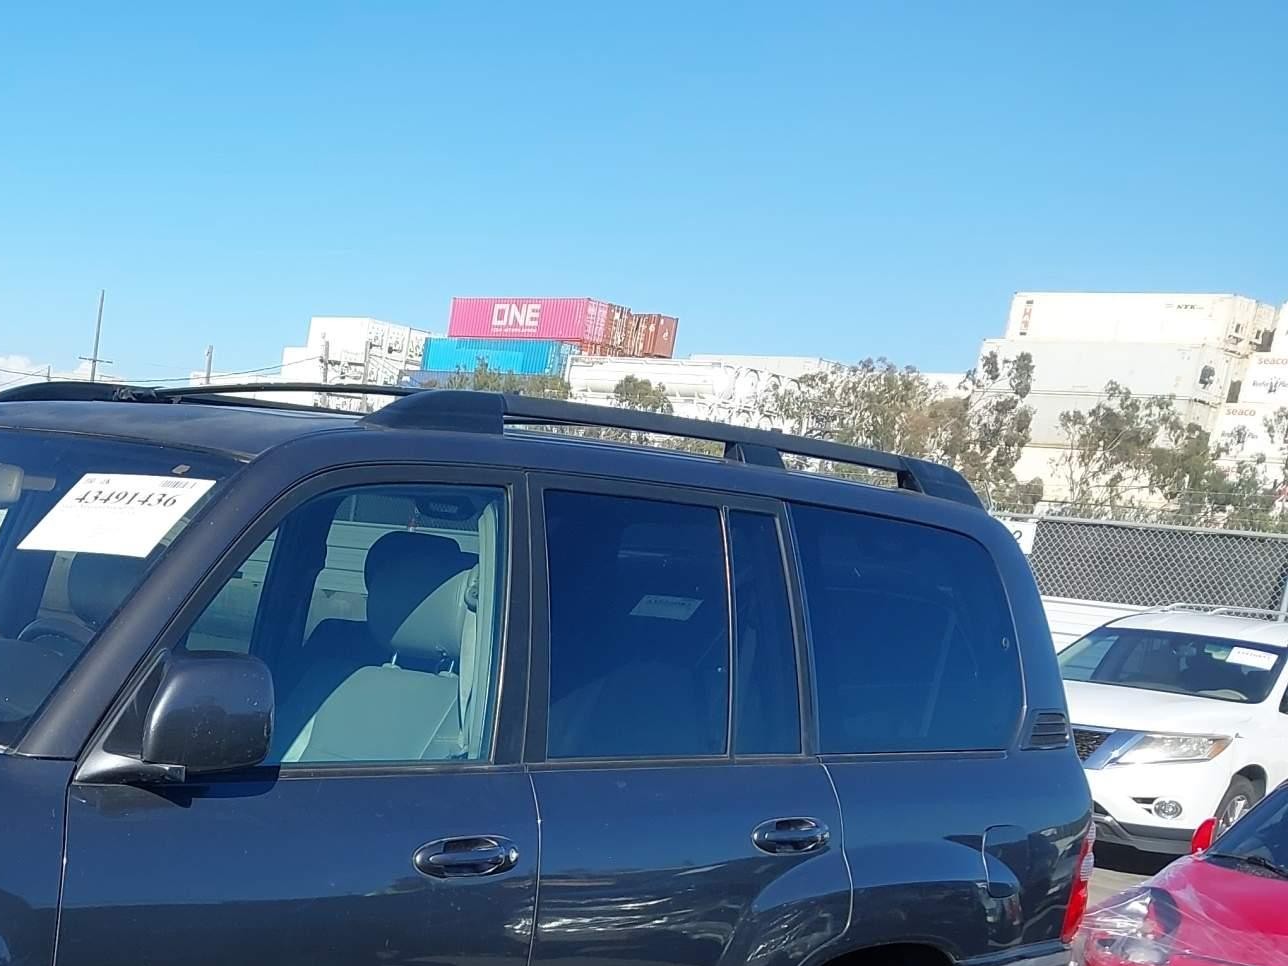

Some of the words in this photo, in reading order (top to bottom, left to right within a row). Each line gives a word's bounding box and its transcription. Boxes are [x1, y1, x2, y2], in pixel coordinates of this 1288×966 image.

[491, 303, 542, 326] ONE
[1225, 409, 1257, 417] seaco
[75, 490, 179, 507] 43491436
